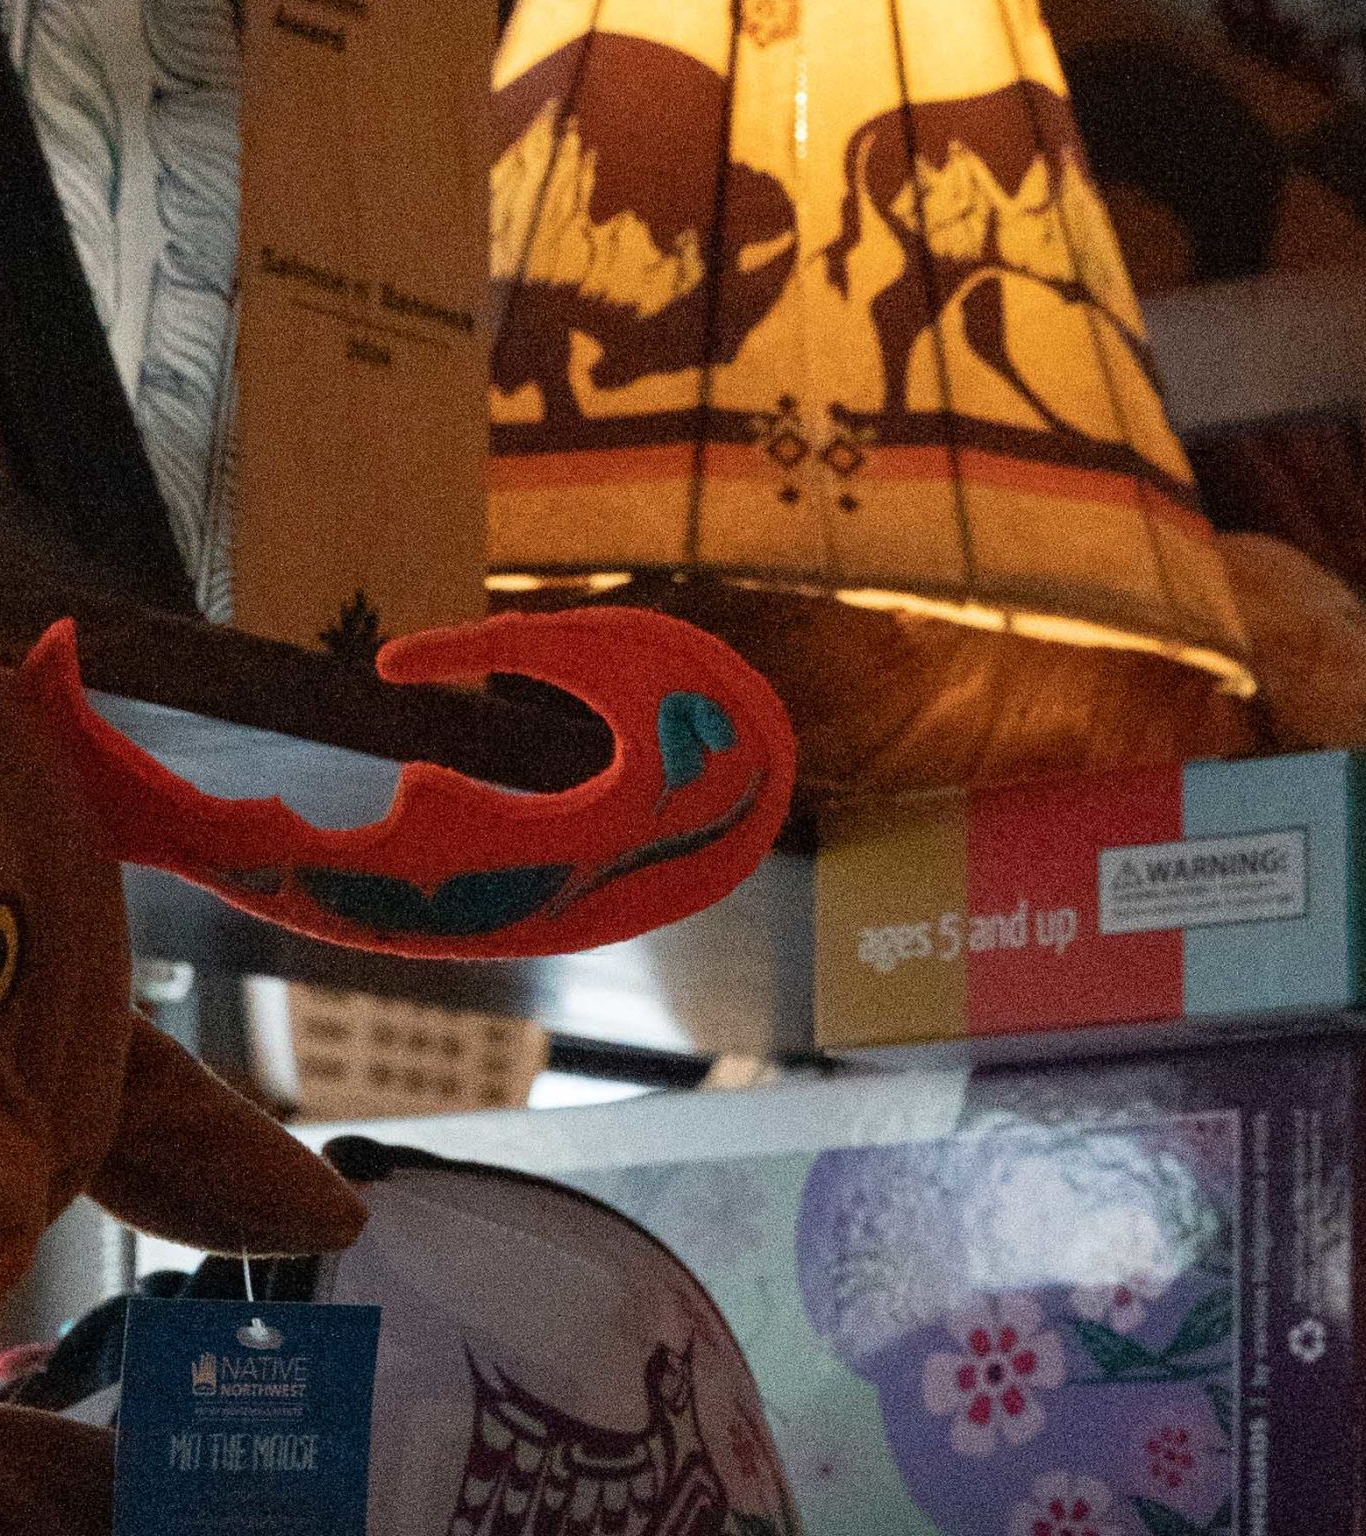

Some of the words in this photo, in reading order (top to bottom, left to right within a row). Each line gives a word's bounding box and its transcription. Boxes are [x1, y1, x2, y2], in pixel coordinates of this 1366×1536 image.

[857, 921, 933, 974] ages
[938, 912, 960, 961] 5
[968, 899, 1029, 953] and
[1037, 907, 1078, 956] up
[221, 1356, 308, 1382] NATIVE
[209, 1432, 247, 1472] THE
[252, 1432, 319, 1472] MOOSE
